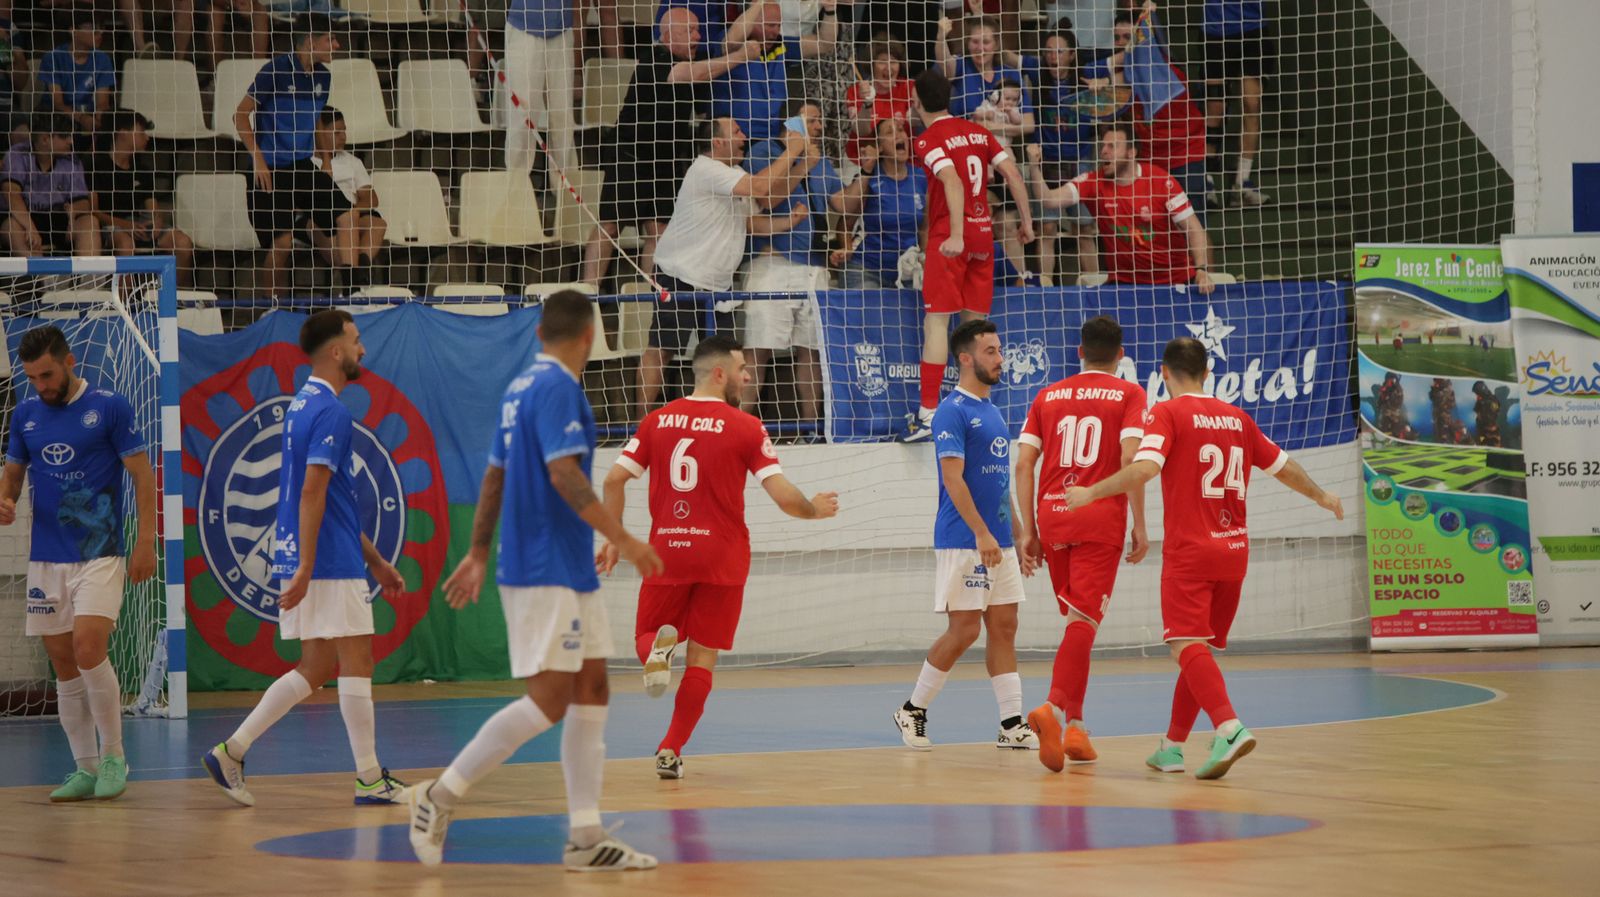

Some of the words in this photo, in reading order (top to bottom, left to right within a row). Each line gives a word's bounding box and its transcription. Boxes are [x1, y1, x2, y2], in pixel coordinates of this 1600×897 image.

[966, 155, 983, 197] 9
[1395, 257, 1430, 277] Jerez
[1435, 257, 1460, 277] Fun
[1466, 258, 1504, 277] Cente
[1529, 253, 1596, 266] ANIMACIÓN
[1548, 266, 1600, 278] EDUCACIÓ
[1573, 281, 1600, 289] EVEN
[1045, 388, 1073, 402] DANI
[1076, 388, 1124, 402] SANTOS
[253, 405, 284, 430] 19
[657, 414, 688, 429] XAVI
[691, 417, 725, 433] COLS
[1193, 414, 1243, 432] ARMANDO
[1057, 415, 1102, 468] 10
[670, 438, 698, 492] 6
[1199, 444, 1246, 500] 24
[1547, 462, 1577, 477] 956
[1582, 461, 1600, 476] 32
[383, 496, 397, 512] C
[208, 508, 221, 525] F
[657, 527, 710, 536] Mercedes-Benz
[1371, 528, 1413, 540] TODO
[669, 540, 691, 548] Leyva
[1372, 544, 1392, 555] LO
[1394, 543, 1426, 557] QUE
[1373, 558, 1453, 570] NECESITAS
[1374, 574, 1394, 585] EN
[1398, 574, 1420, 585] UN
[1423, 573, 1465, 584] SOLO
[225, 565, 275, 610] DEP
[1374, 588, 1440, 600] ESPACIO
